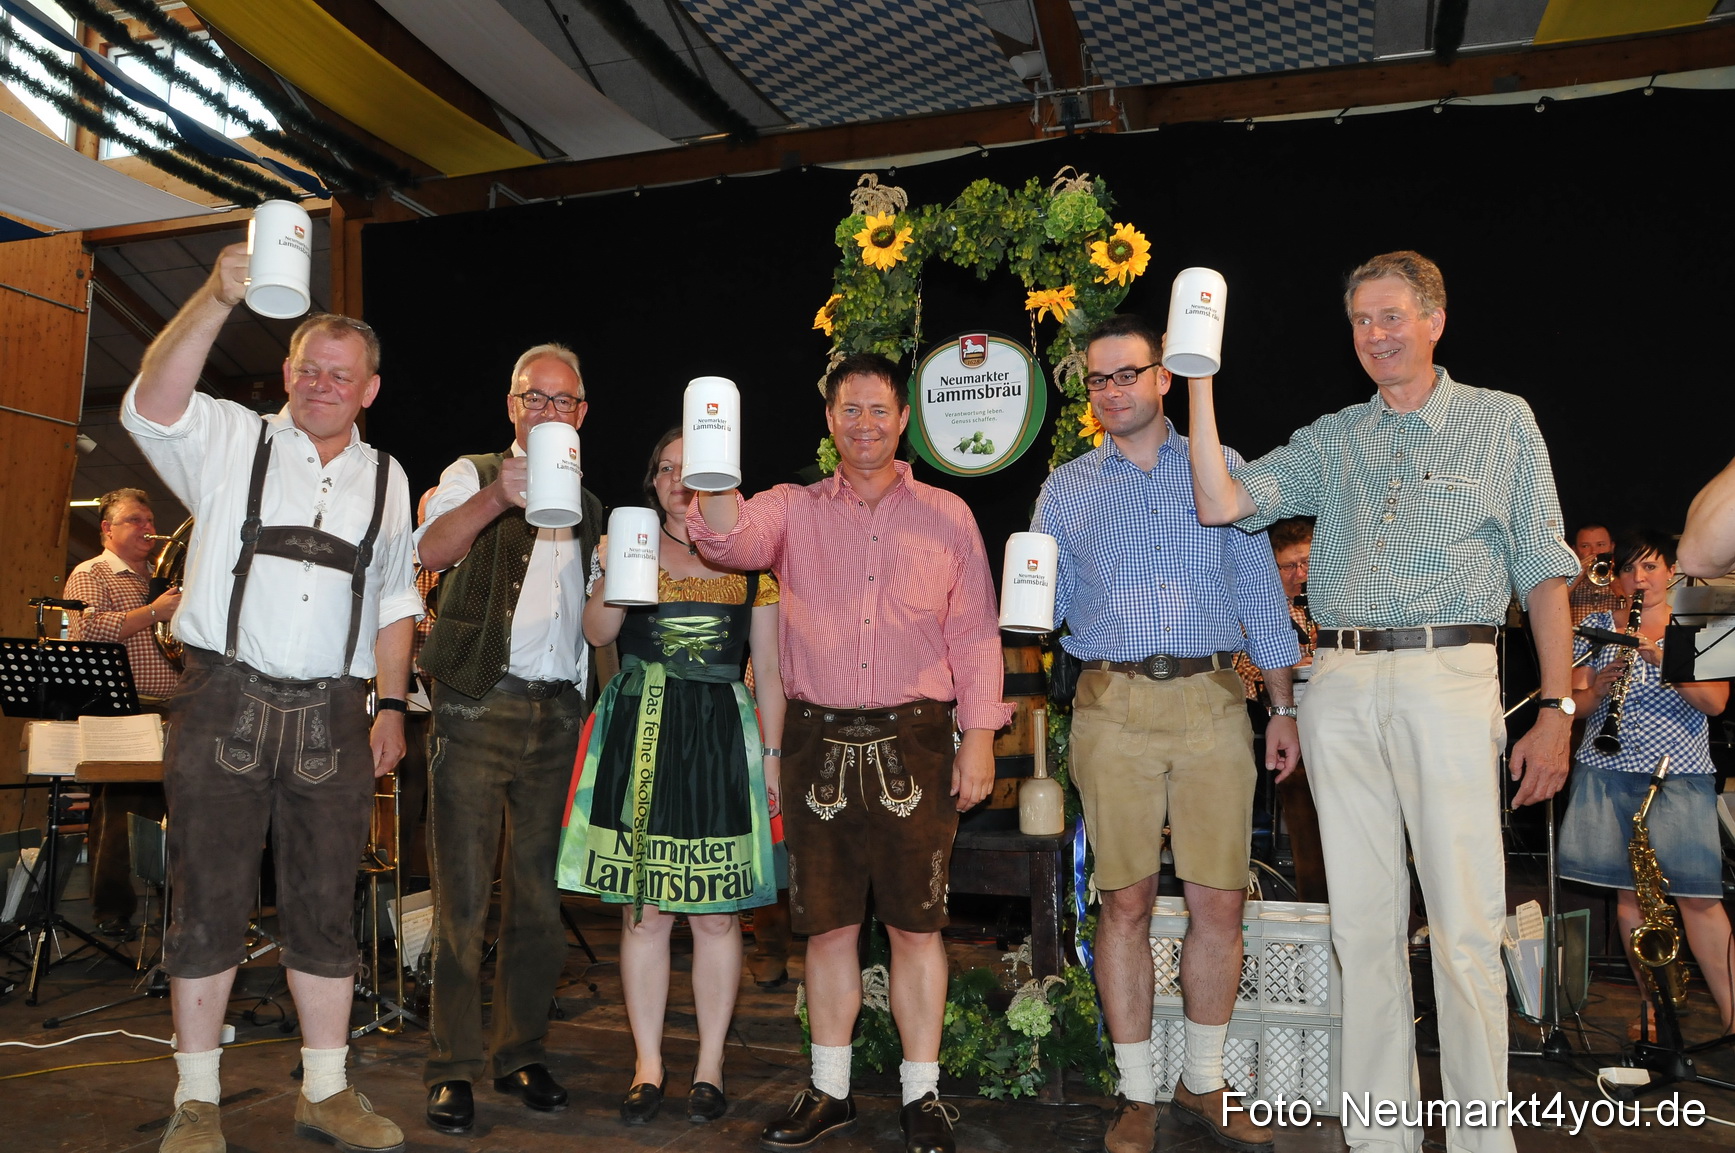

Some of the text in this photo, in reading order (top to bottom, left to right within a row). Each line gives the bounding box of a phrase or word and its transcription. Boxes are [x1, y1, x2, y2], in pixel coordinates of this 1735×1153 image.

[1191, 304, 1217, 313] Neumarker
[940, 371, 1009, 386] Neumarkter
[927, 382, 1021, 403] Lammsbräu
[944, 409, 986, 417] Verantwortung
[1013, 578, 1048, 587] Lammsbräu
[634, 684, 664, 911] Das feine ökologische Bier
[613, 831, 735, 865] Nmarkter
